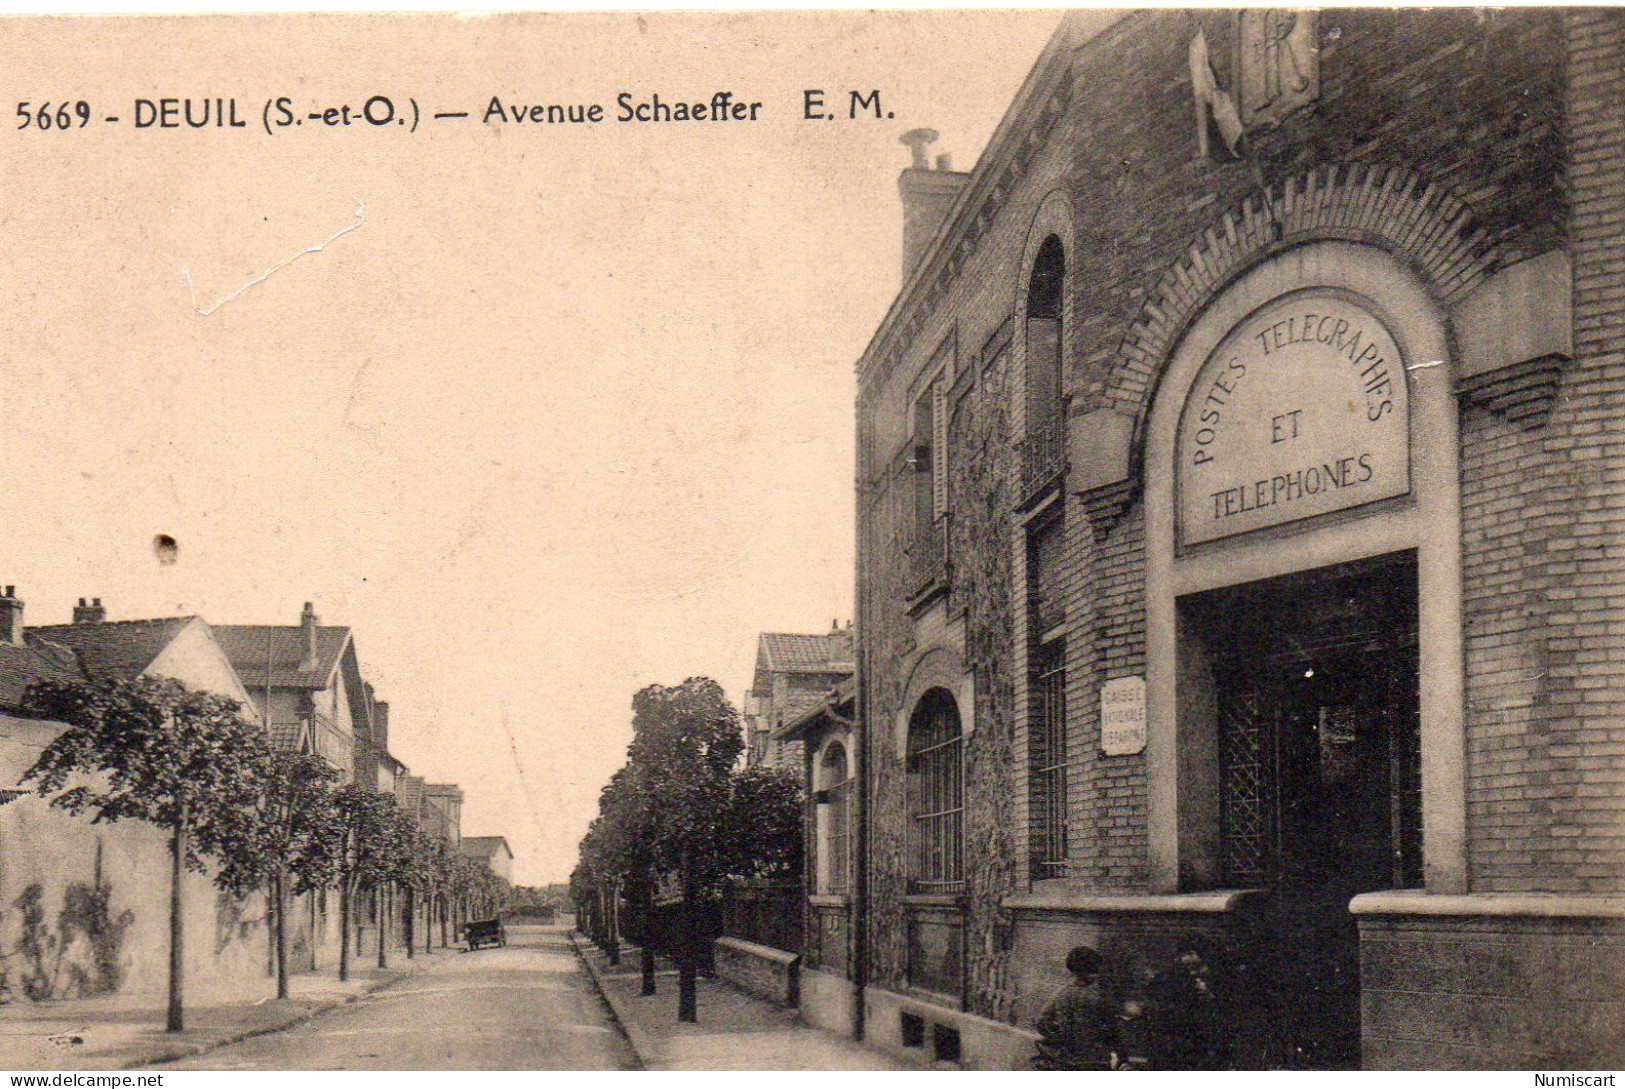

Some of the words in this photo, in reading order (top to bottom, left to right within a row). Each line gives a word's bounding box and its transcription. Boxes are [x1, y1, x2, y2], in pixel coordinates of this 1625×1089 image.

[1194, 357, 1247, 465] POSTES
[1256, 314, 1393, 422] TELEGRAPHES
[1271, 410, 1303, 444] ET
[1210, 453, 1373, 519] TELEPHONES
